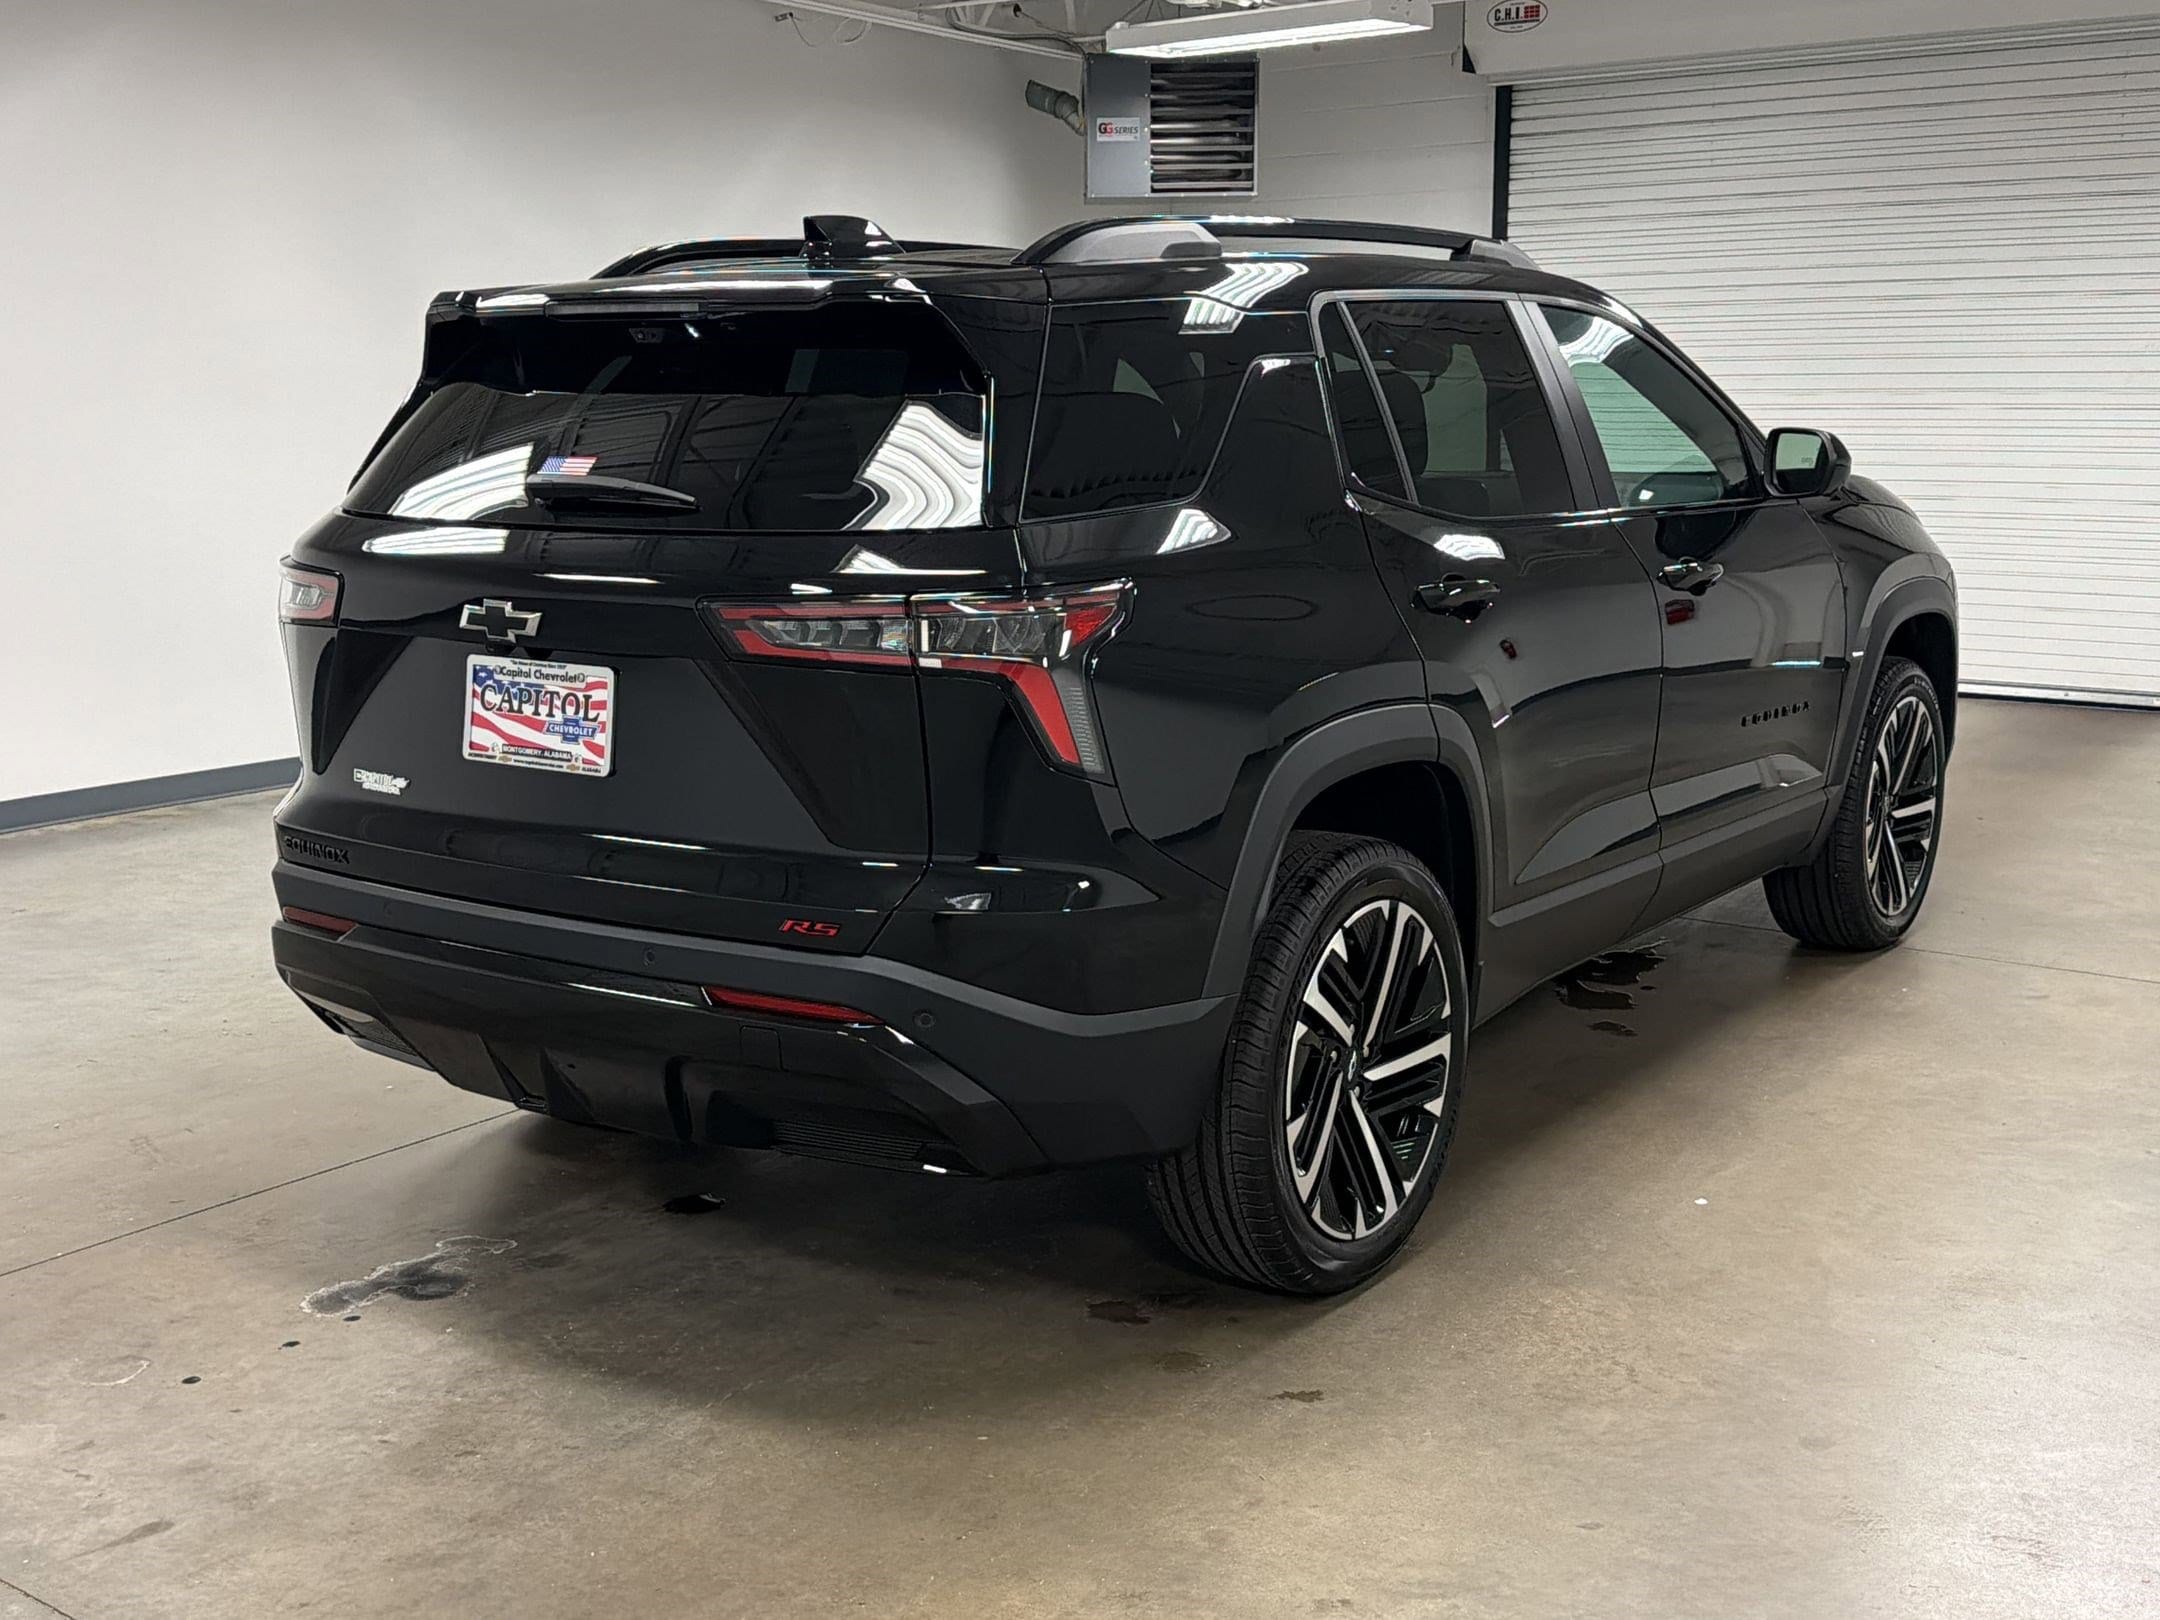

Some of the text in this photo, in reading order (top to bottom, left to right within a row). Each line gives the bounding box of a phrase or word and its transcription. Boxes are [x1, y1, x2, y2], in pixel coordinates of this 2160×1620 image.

[1114, 126, 1138, 134] SERIES
[500, 665, 577, 684] Capitol Chevrolet
[480, 684, 600, 722] CAPITOL
[549, 723, 593, 736] CHEVROLET
[544, 749, 571, 759] ALABAMA
[284, 835, 350, 864] EQUINOX
[778, 919, 840, 937] RS
